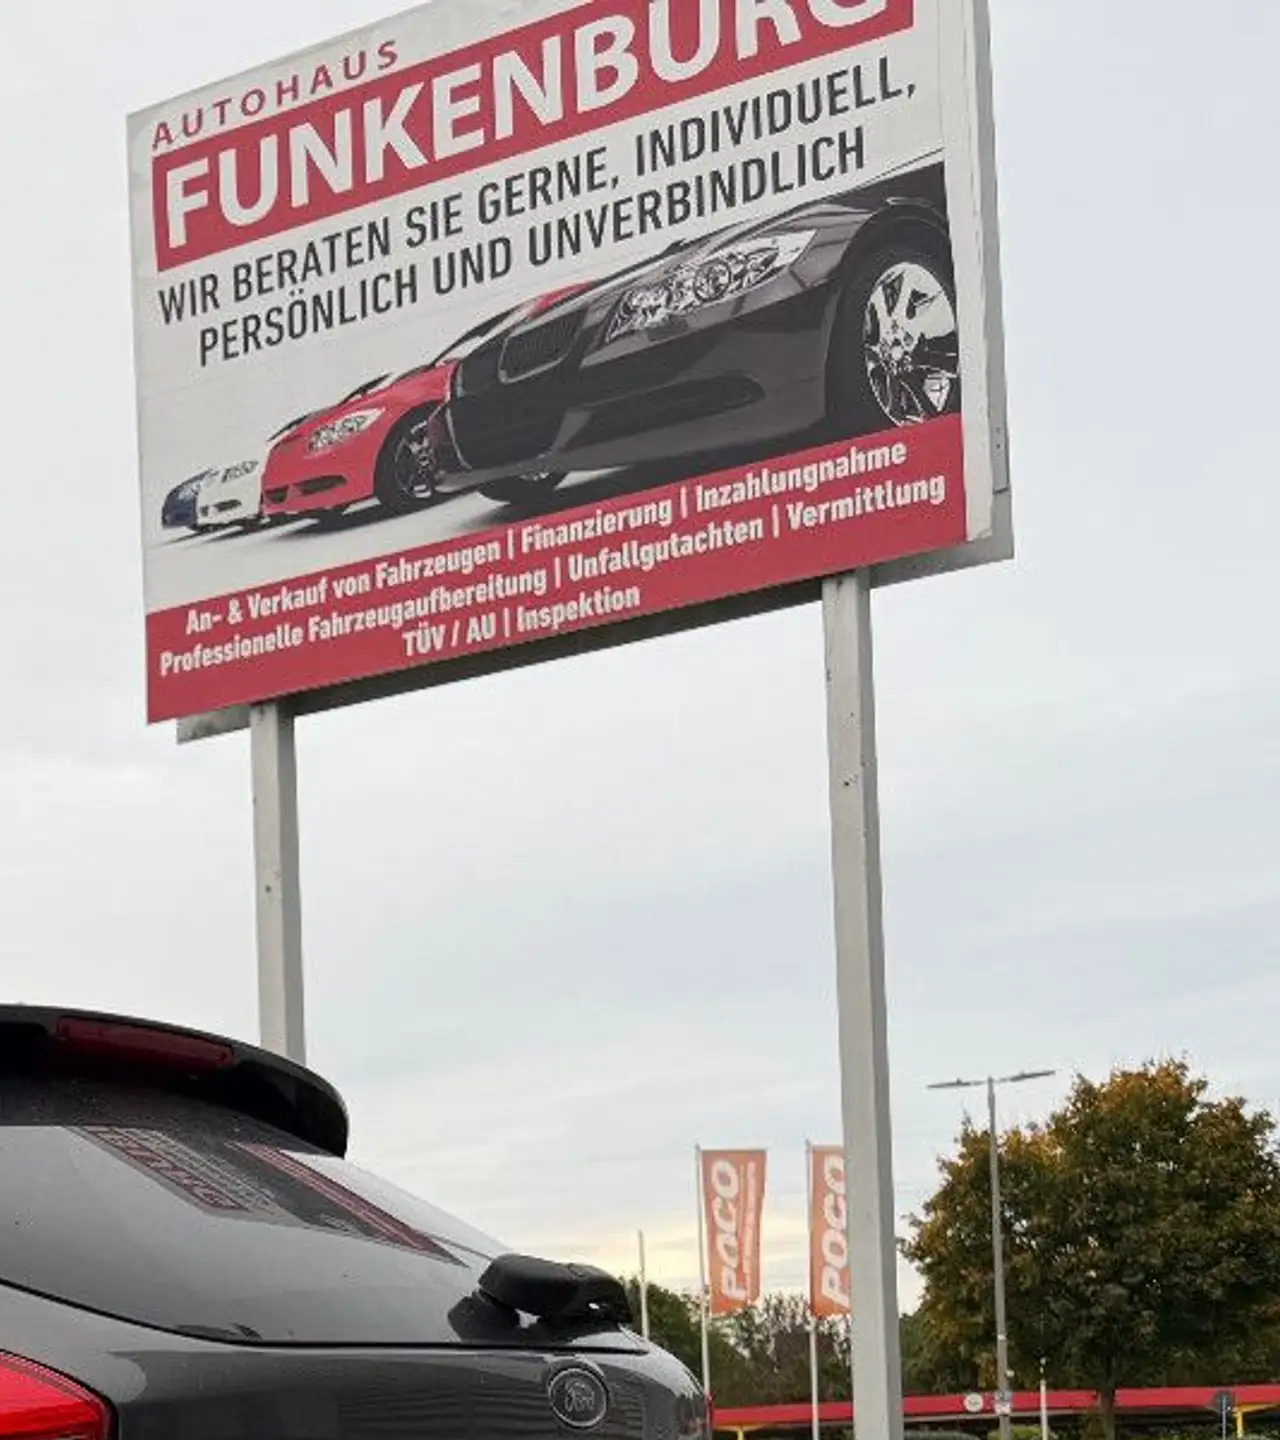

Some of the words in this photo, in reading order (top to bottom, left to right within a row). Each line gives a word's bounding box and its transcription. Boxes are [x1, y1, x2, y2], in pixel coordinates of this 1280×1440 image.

[152, 40, 398, 150] AUTOHAUS
[159, 273, 219, 325] WIR
[233, 217, 391, 302] BERATEN
[406, 193, 463, 249] SIE
[478, 147, 620, 225] GERNE,
[635, 56, 917, 177] INDIVIDUELL,
[200, 264, 417, 367] PERSÖNLICH
[434, 237, 512, 296] UND
[529, 126, 865, 267] UNVERBINDLICH
[159, 626, 304, 676] Professionelle
[307, 567, 547, 643] Fahrzeugaufbereitung
[568, 517, 764, 583] Unfallgutachten
[786, 474, 946, 533] Vermittlung
[185, 608, 222, 635] An-
[227, 598, 244, 624] &
[247, 577, 328, 621] Verkauf
[332, 572, 371, 601] von
[375, 538, 501, 589] Fahrzeugen
[521, 496, 673, 555] Finanzierung
[695, 441, 908, 513] Inzahlungnahme
[402, 622, 446, 657] TÜV
[466, 610, 497, 642] AU
[516, 584, 641, 633] Inspektion
